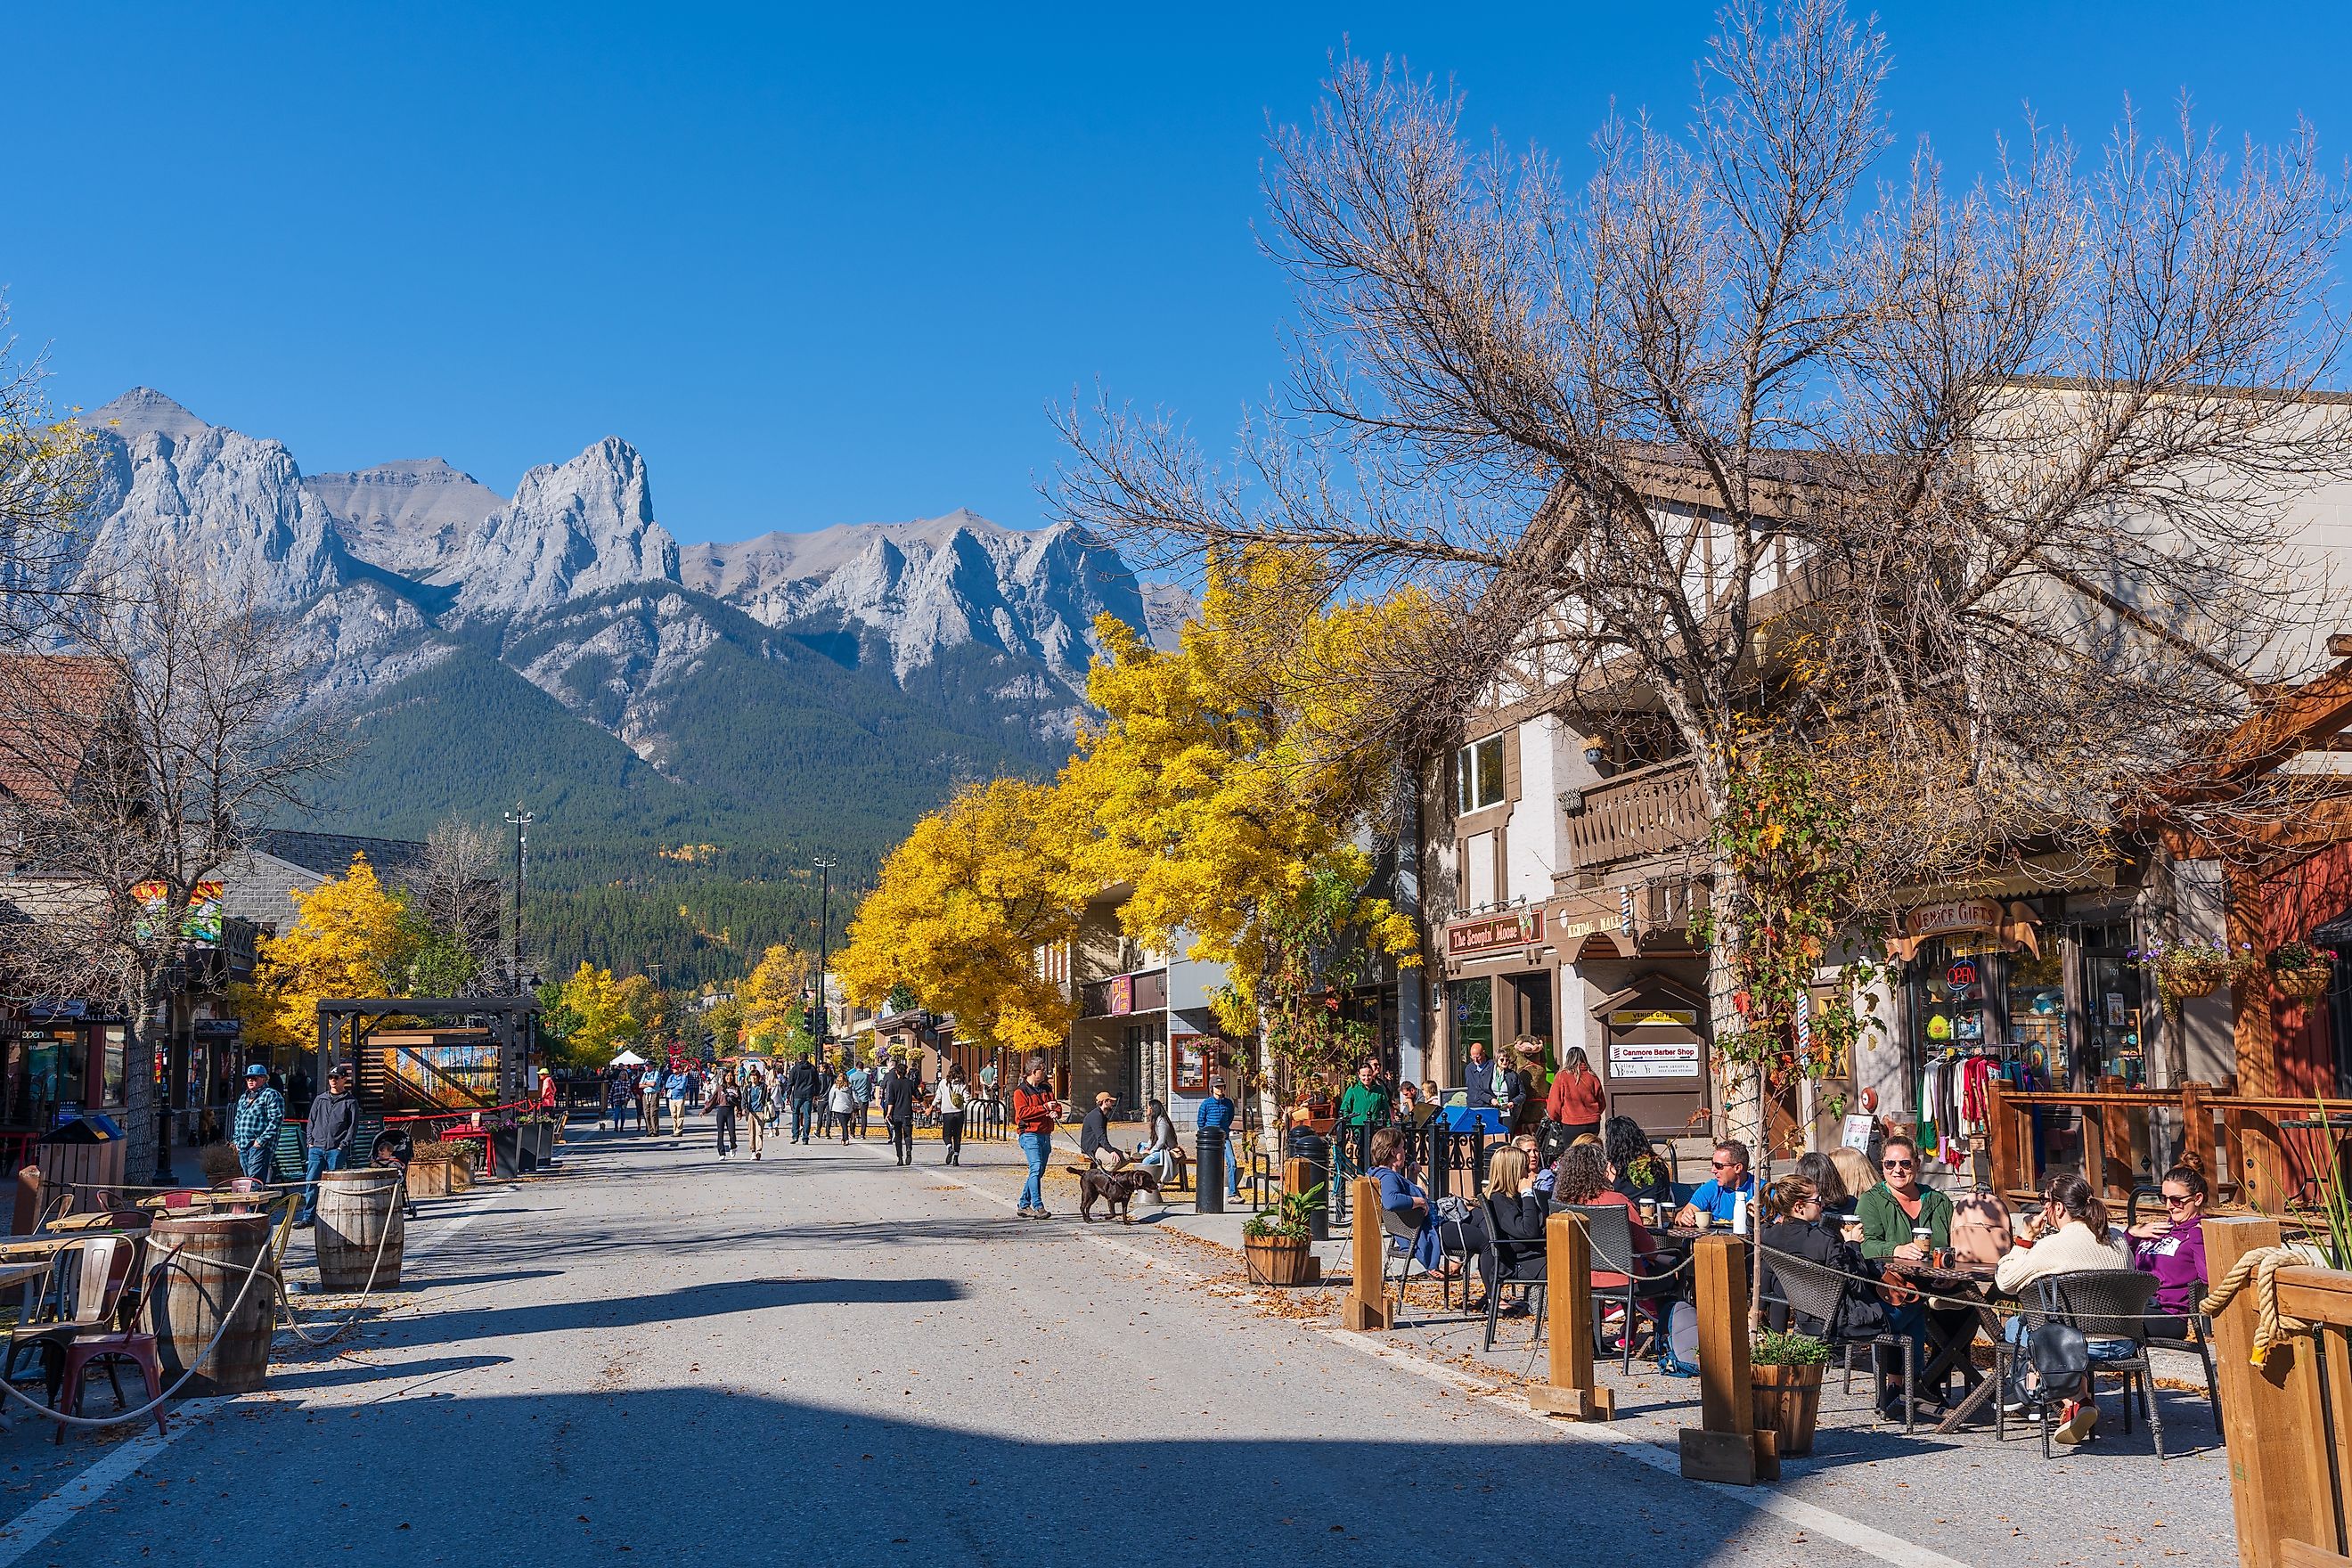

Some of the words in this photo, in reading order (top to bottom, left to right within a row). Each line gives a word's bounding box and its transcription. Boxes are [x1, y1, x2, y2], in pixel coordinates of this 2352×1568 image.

[1913, 909, 1956, 927] VENICE
[1958, 902, 1994, 926] GIFTS
[1453, 931, 1466, 948] The
[1496, 924, 1517, 941] Moose
[1947, 968, 1975, 984] OPEN
[21, 1031, 44, 1039] open
[1677, 1048, 1695, 1056] Shop
